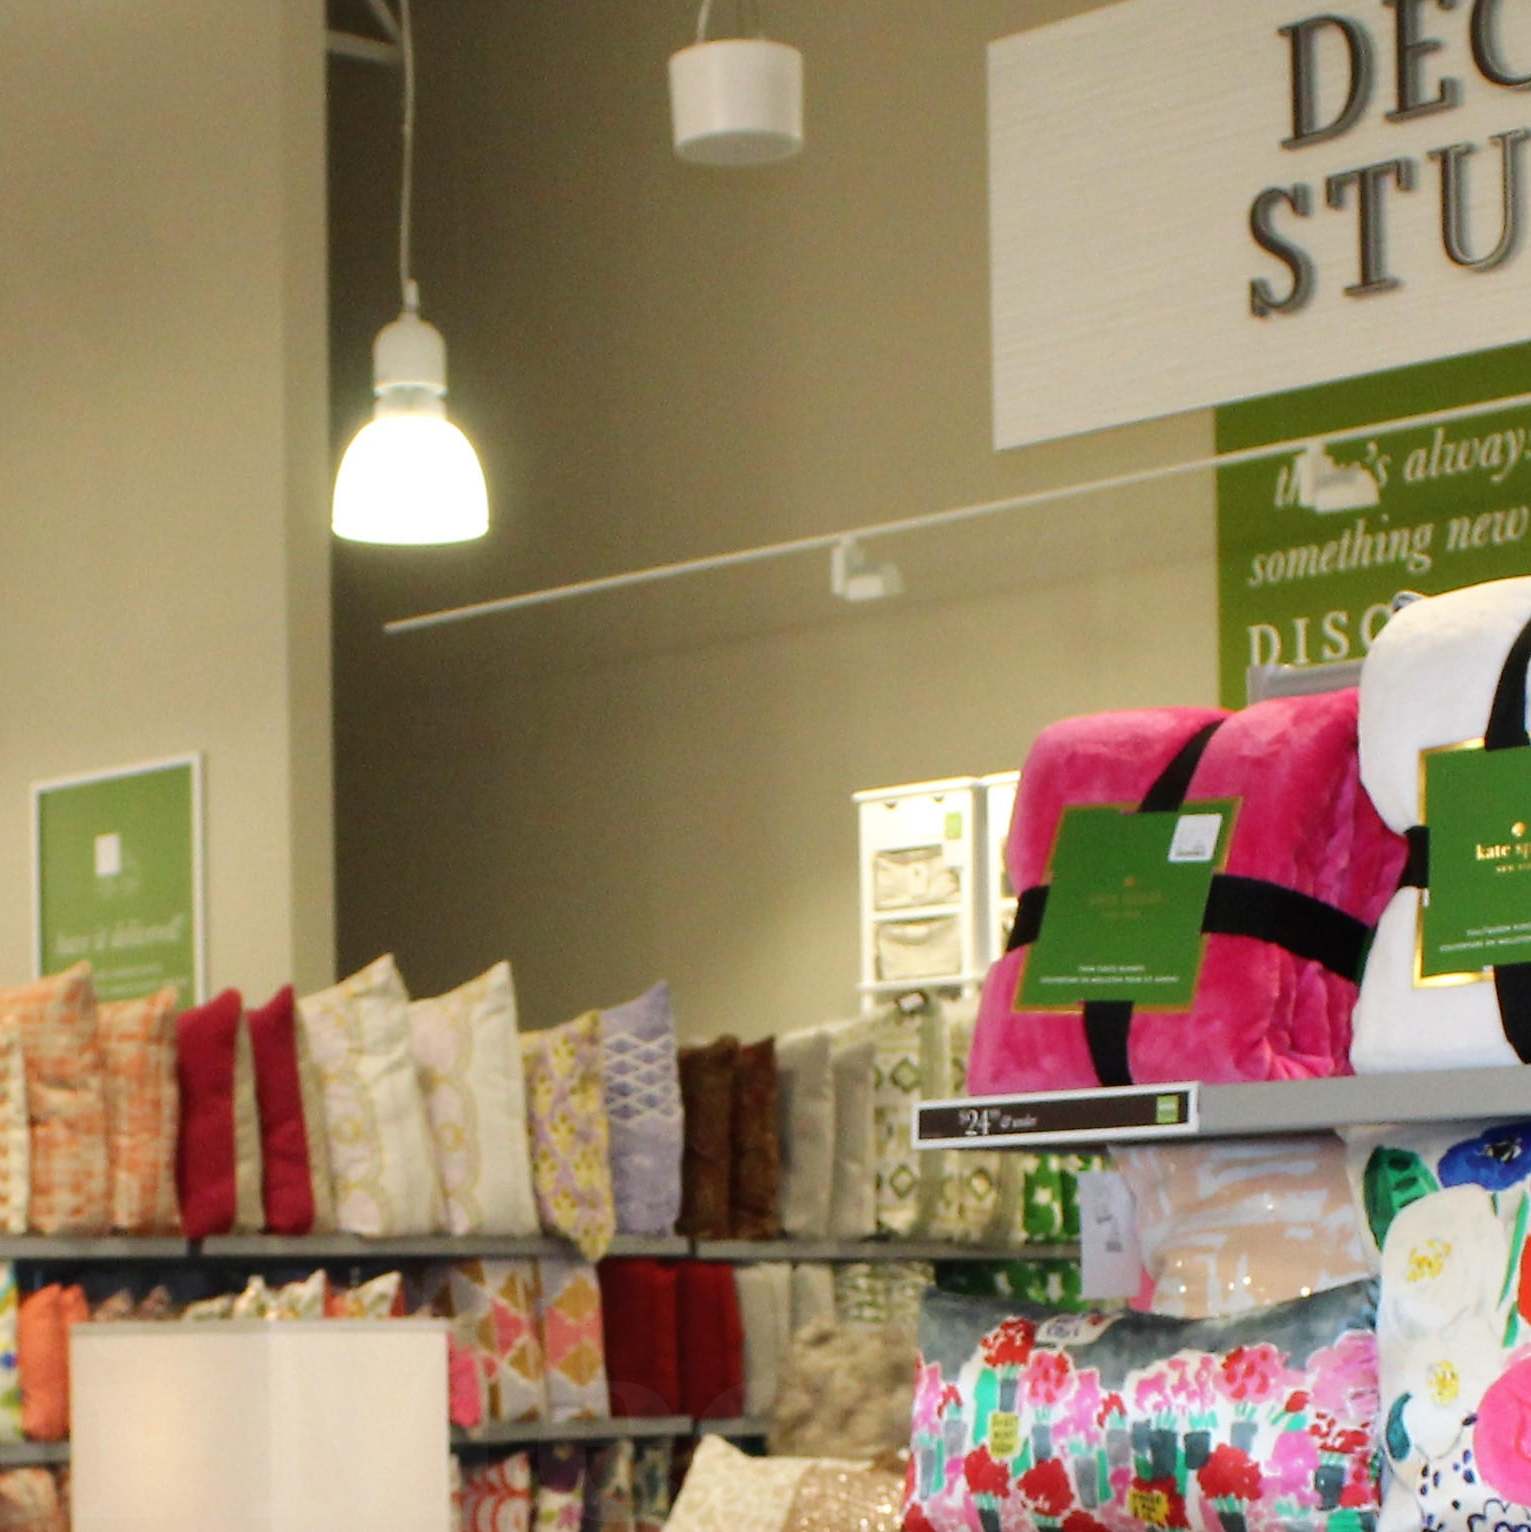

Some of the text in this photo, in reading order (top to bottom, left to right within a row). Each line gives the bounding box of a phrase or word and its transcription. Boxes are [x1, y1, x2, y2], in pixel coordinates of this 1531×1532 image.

[1248, 513, 1435, 588] something
[1446, 507, 1528, 551] new
[1476, 843, 1511, 860] kate
